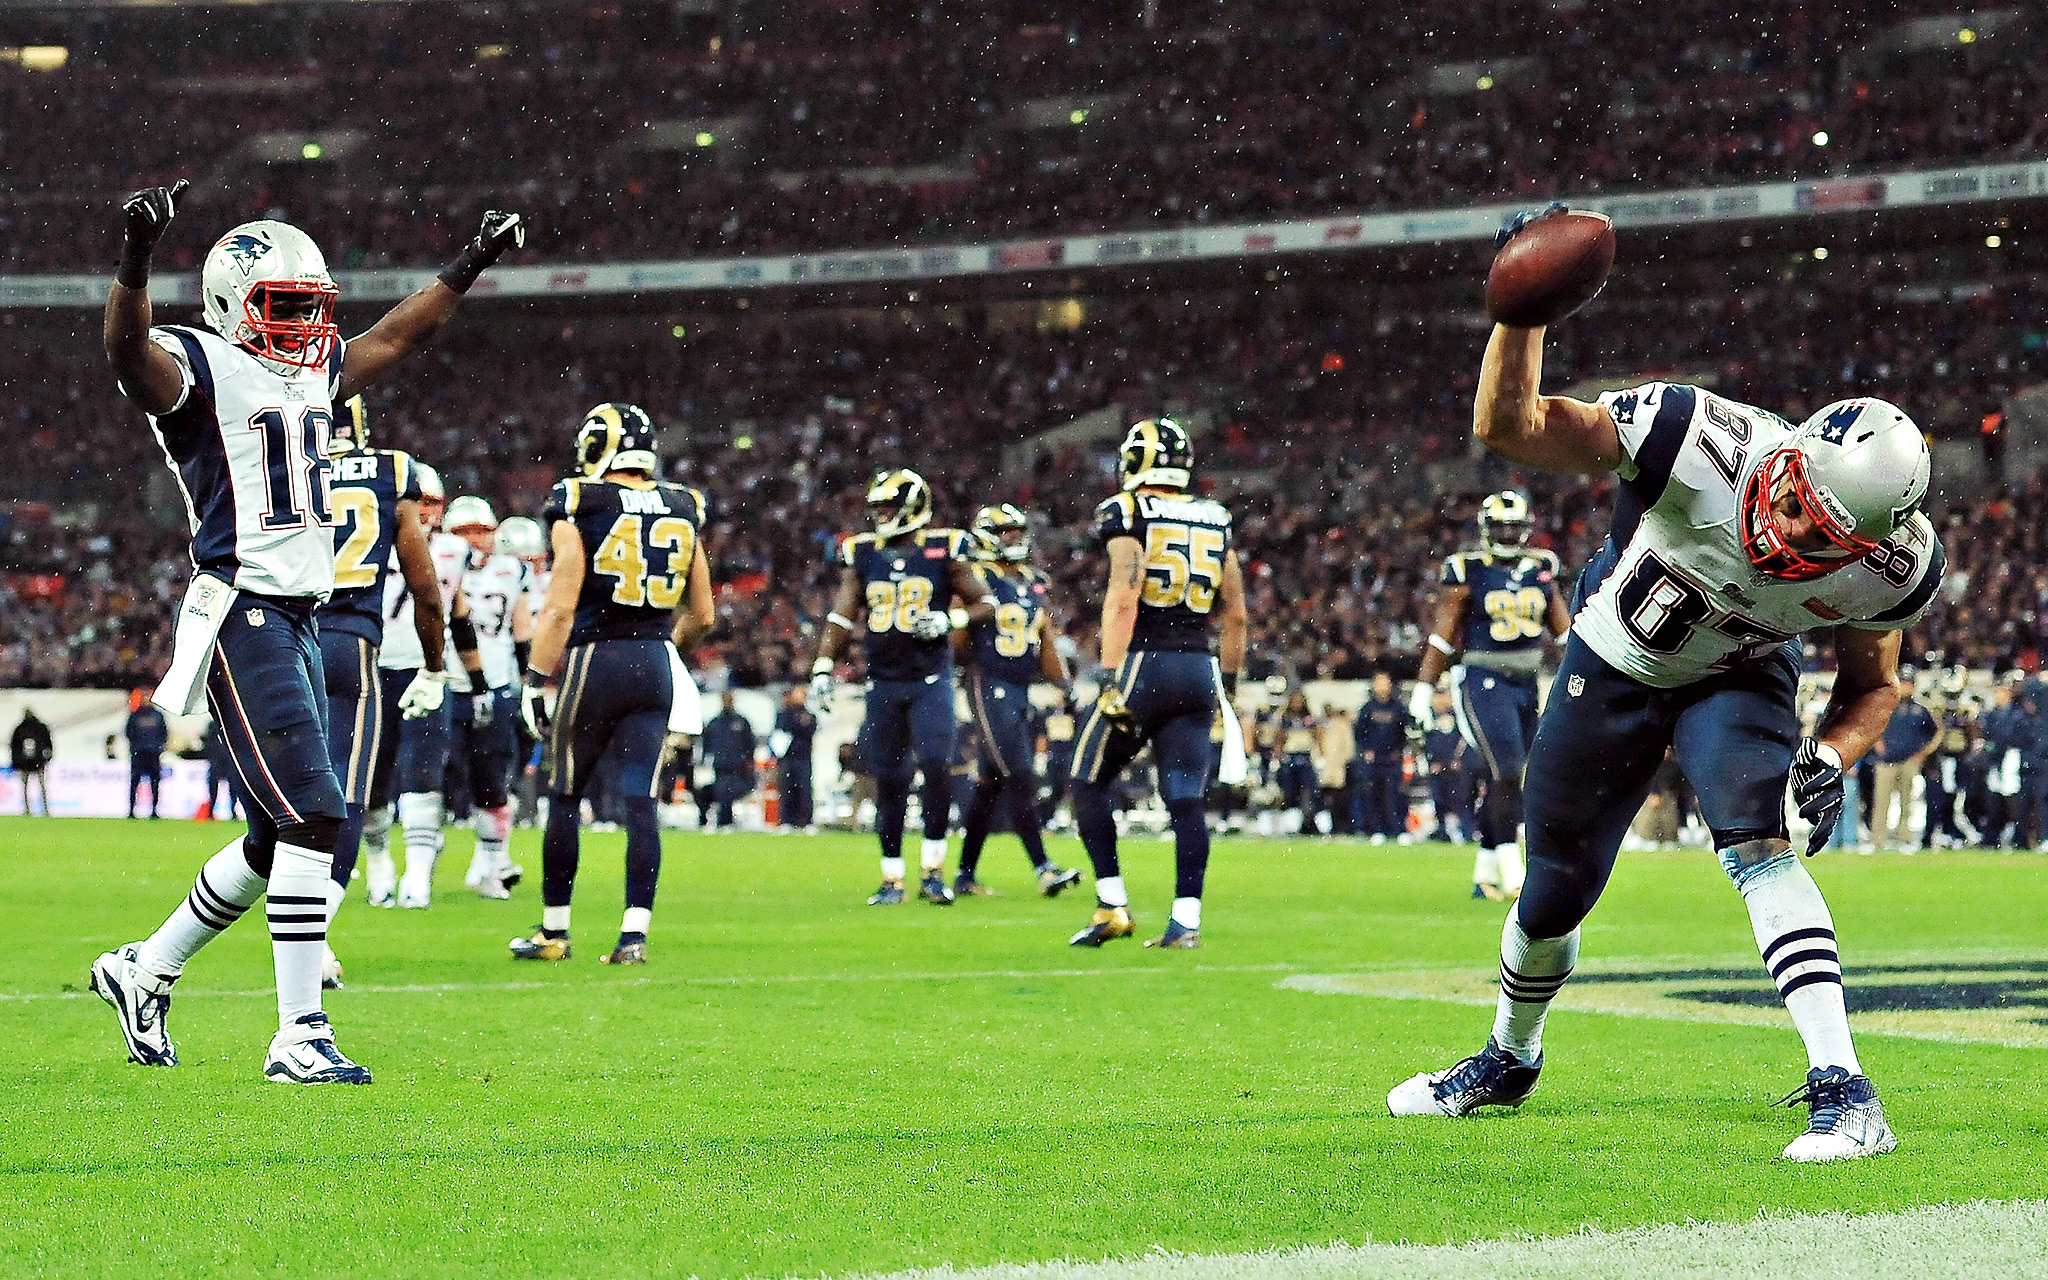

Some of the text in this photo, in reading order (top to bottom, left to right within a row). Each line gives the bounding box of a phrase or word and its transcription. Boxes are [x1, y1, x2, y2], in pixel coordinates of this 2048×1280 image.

[247, 404, 333, 531] 18
[330, 456, 378, 482] HER
[1696, 396, 1752, 493] 87
[1823, 497, 1848, 522] Riddell
[593, 513, 696, 609] 43
[1142, 522, 1226, 614] 55
[1615, 547, 1797, 670] 87
